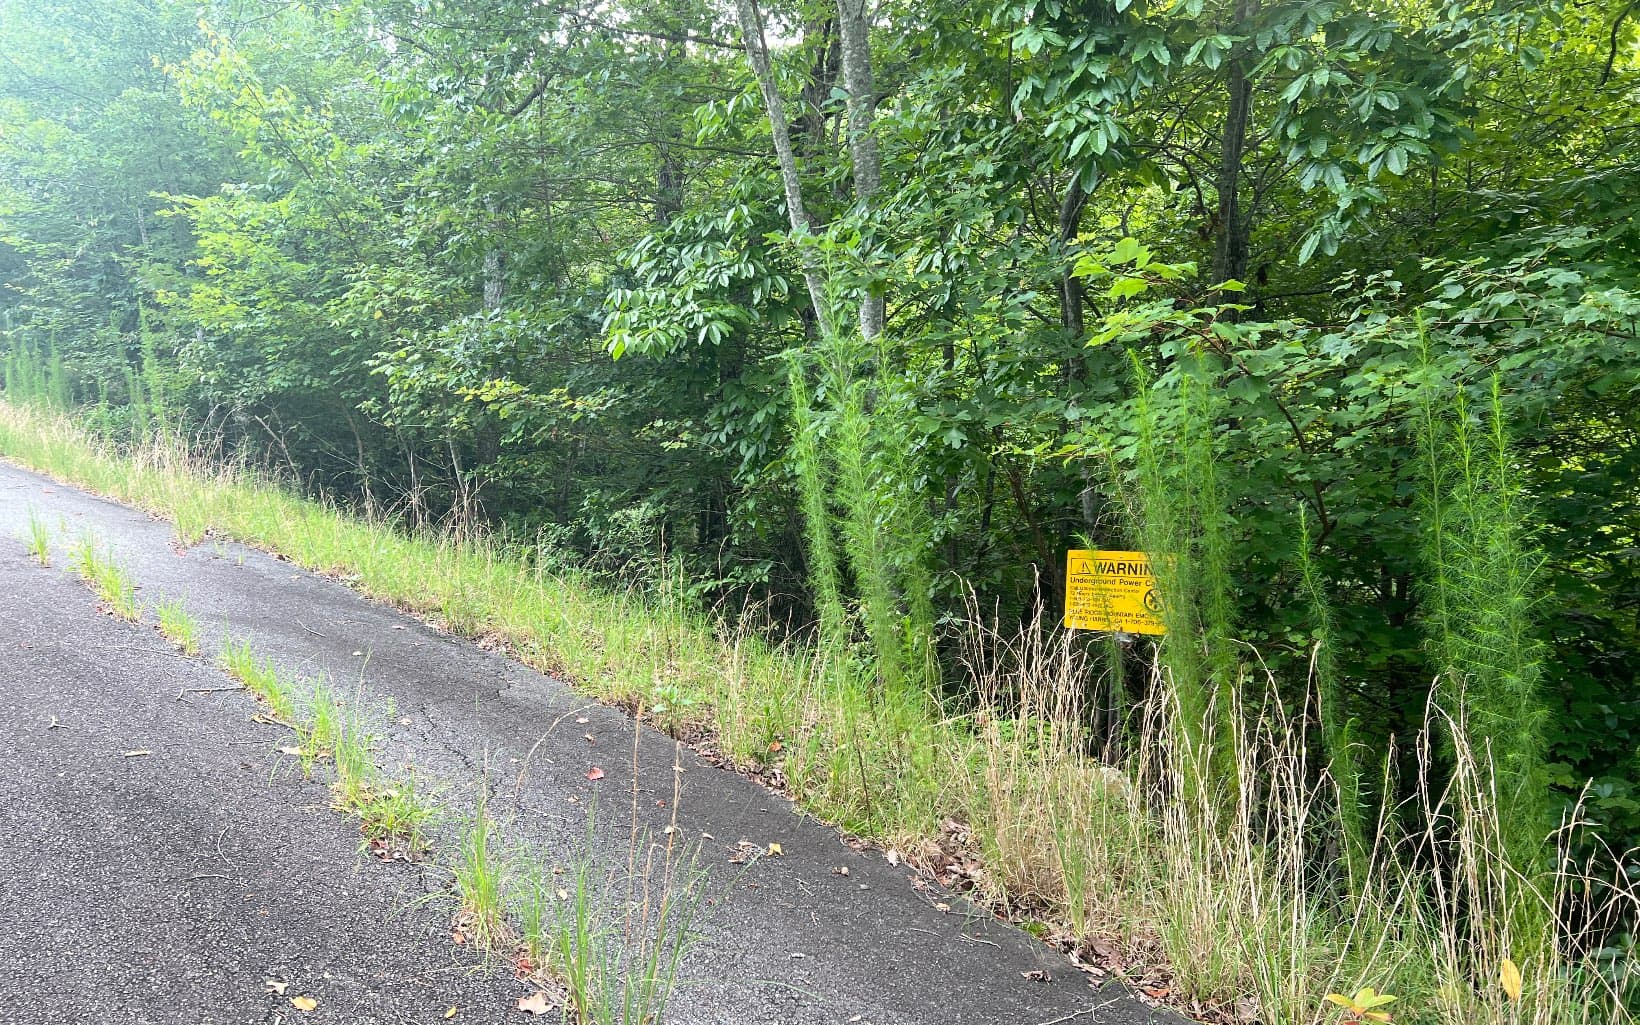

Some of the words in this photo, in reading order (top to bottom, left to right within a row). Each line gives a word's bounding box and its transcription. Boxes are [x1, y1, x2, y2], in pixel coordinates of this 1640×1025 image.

[1094, 562, 1154, 576] WARNIN
[1070, 577, 1116, 586] Underground
[1119, 578, 1142, 587] Power
